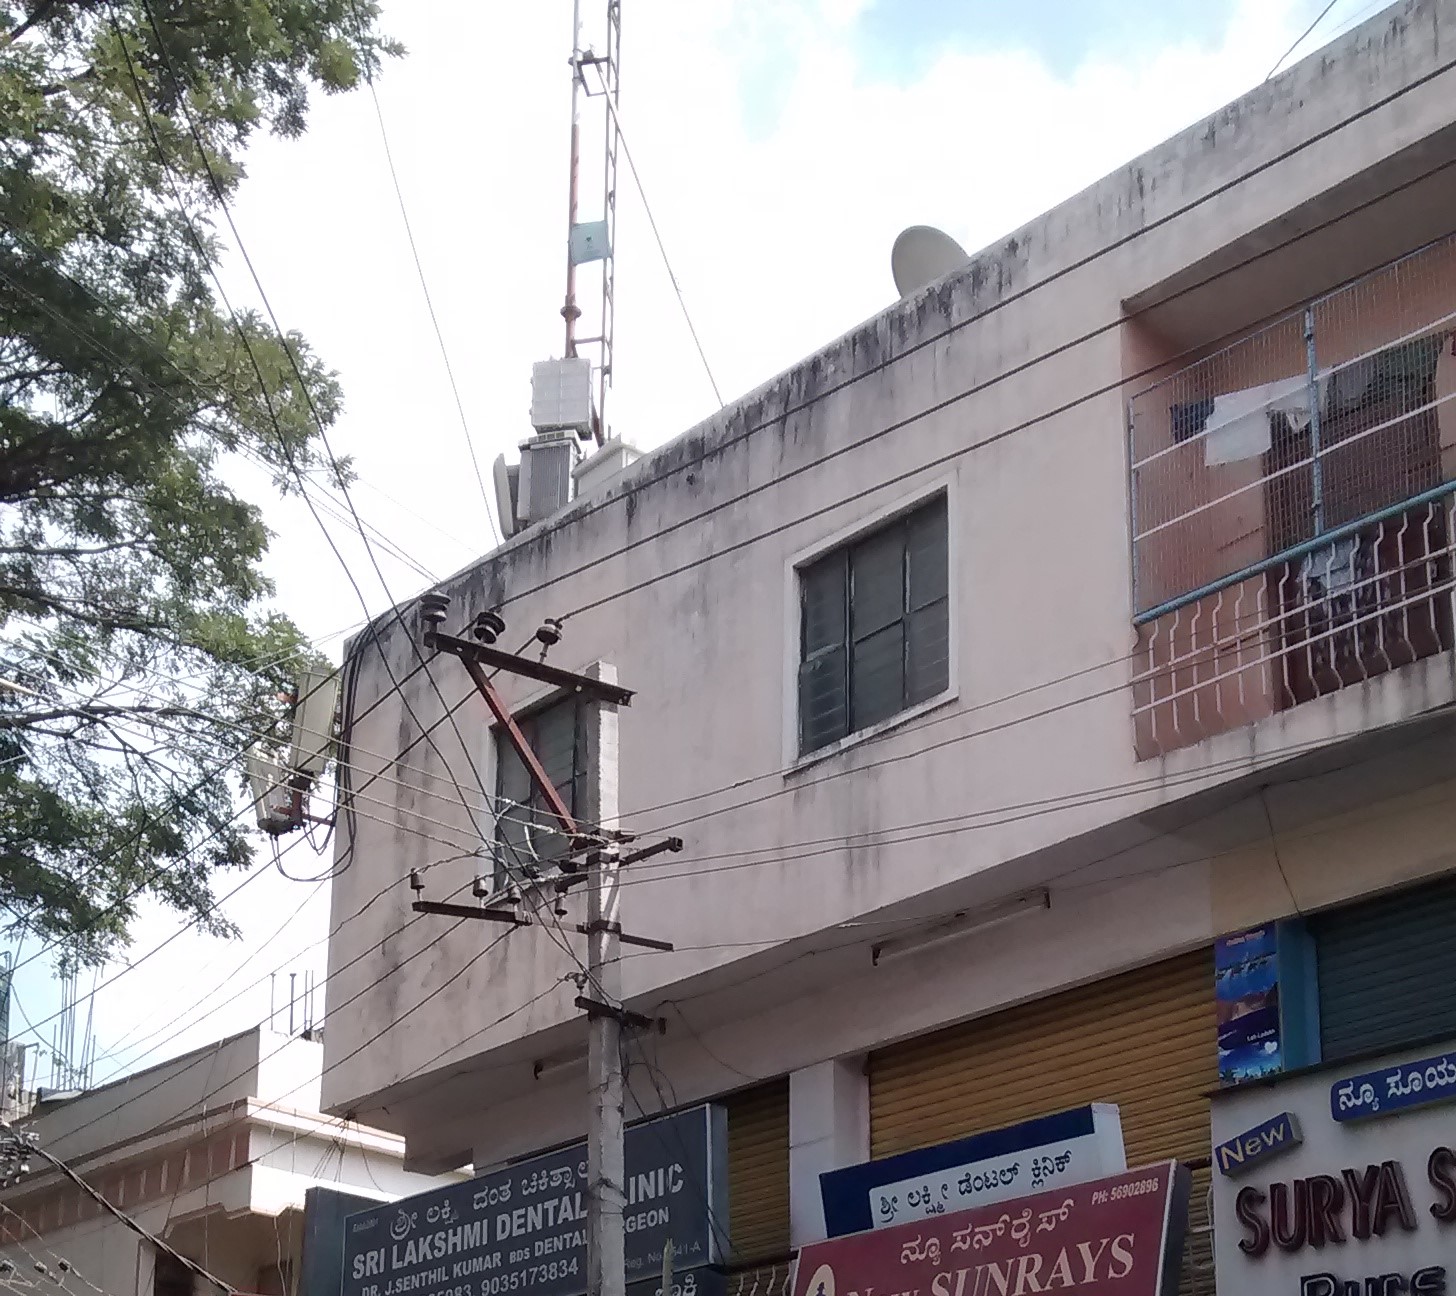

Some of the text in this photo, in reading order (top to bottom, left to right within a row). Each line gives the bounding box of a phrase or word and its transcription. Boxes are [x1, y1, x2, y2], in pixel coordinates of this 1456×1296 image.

[1220, 1122, 1285, 1170] New
[352, 1163, 684, 1279] SRI LAKSHMI DENTAL INIC
[1091, 1177, 1159, 1205] PH: 56902896
[1235, 1146, 1456, 1256] SURYA S
[453, 1251, 502, 1279] KUMAR
[534, 1229, 589, 1257] DENTAL
[625, 1206, 671, 1234] GEON
